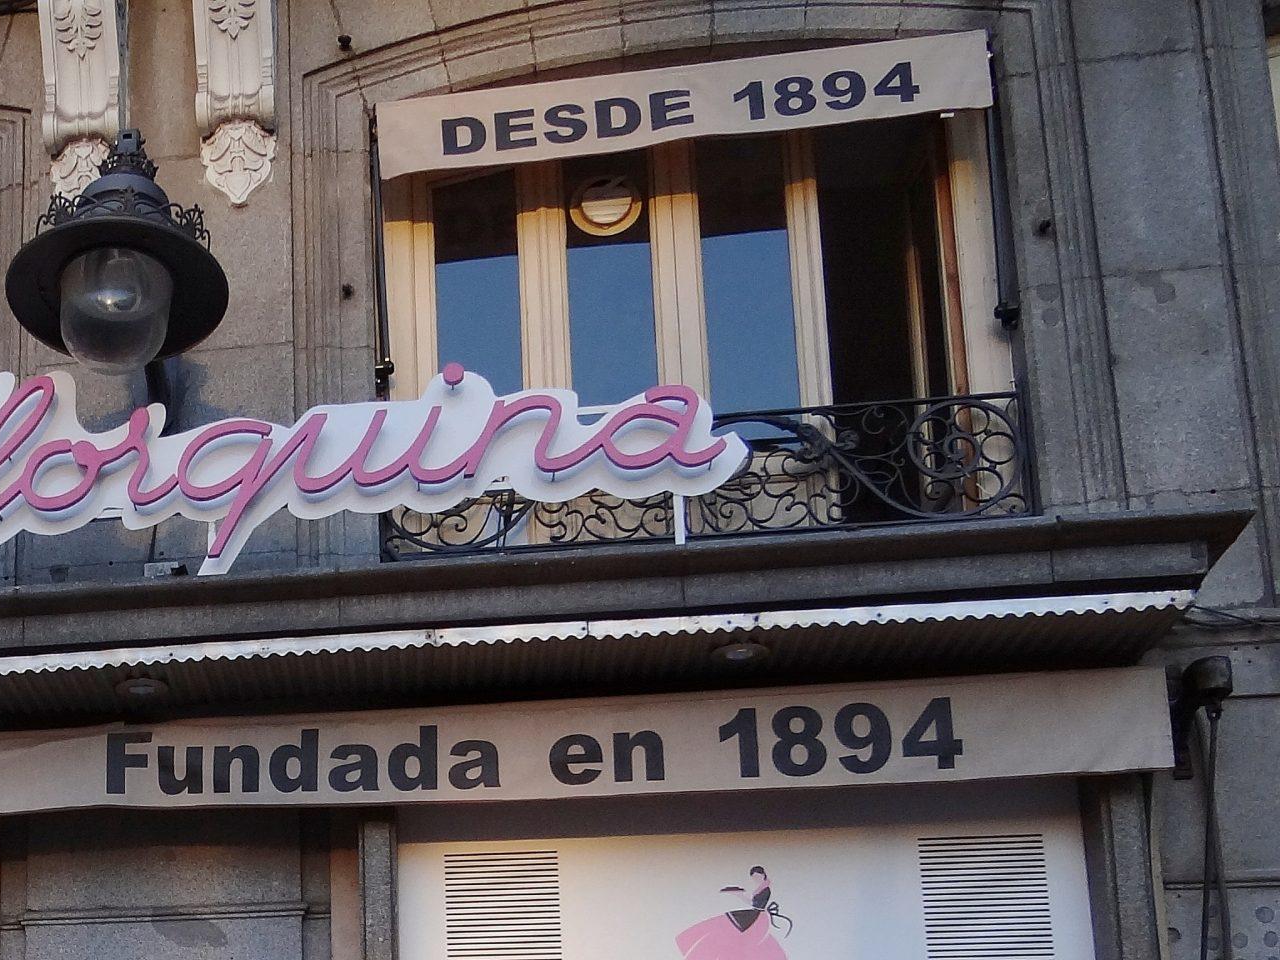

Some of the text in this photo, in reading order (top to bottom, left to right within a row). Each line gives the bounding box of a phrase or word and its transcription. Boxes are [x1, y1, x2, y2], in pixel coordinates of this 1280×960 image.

[440, 61, 921, 156] DESDE 1894
[105, 697, 964, 795] Fundada en 1894
